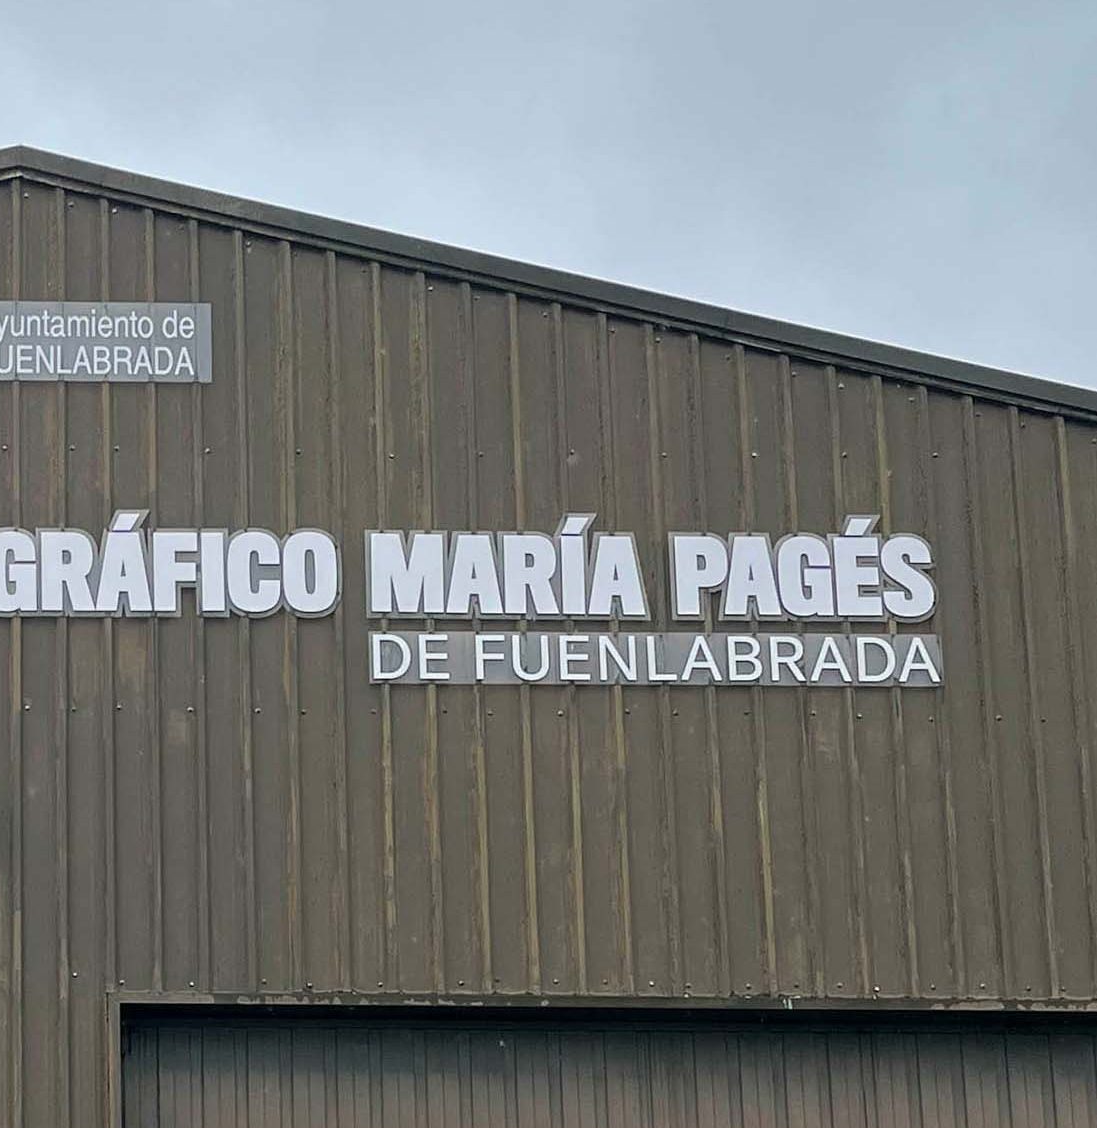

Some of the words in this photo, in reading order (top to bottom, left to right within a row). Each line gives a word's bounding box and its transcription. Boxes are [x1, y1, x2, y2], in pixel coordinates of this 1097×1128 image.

[162, 309, 195, 339] de
[370, 514, 647, 616] MARÍA
[673, 517, 937, 618] PAGÉS
[371, 634, 451, 681] DE
[474, 634, 942, 683] FUENLABRADA
